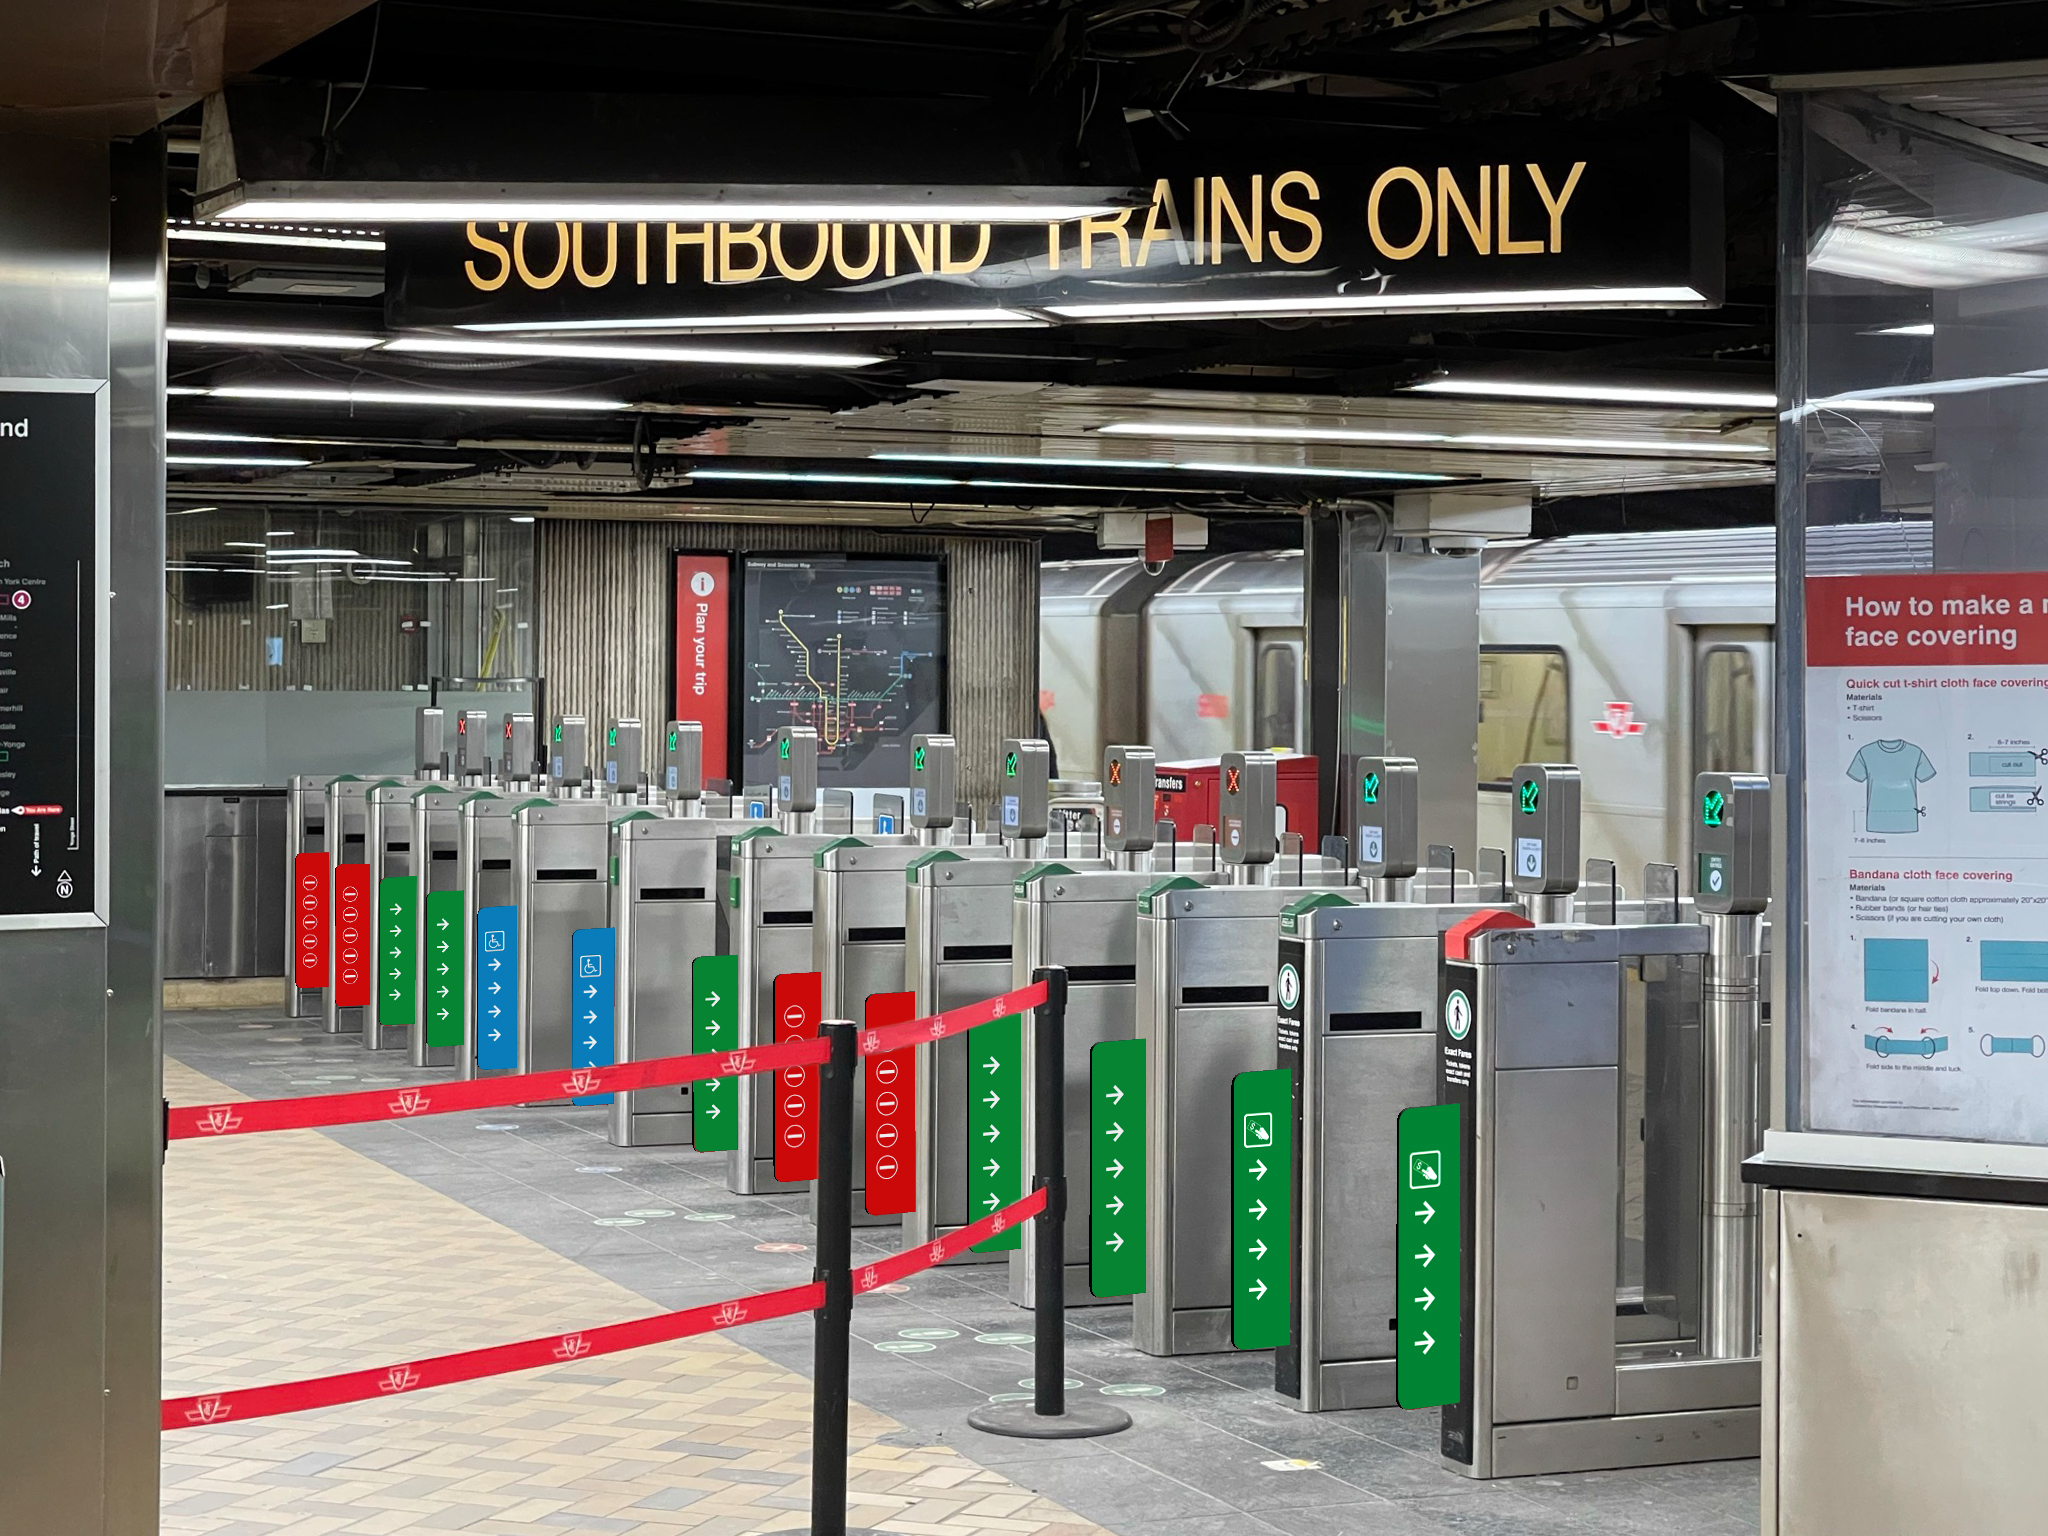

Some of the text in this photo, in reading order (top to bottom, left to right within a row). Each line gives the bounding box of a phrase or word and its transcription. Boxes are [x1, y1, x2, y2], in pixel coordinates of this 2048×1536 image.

[1367, 160, 1589, 262] ONLY
[17, 595, 25, 605] 4
[1845, 596, 1901, 617] How
[1908, 596, 1933, 616] to
[1942, 595, 2011, 616] make
[2018, 599, 2034, 615] a
[1845, 625, 2017, 650] face covering
[692, 603, 709, 696] Plan your trip
[1846, 677, 2048, 689] Quick cut t-shirt cloth face covering
[1846, 693, 1883, 701] Materials
[1853, 704, 1875, 712] T-shirt
[1853, 714, 1883, 722] Scissors
[2010, 738, 2031, 746] inches
[1154, 775, 1184, 791] ransfers
[33, 841, 40, 849] of
[1849, 869, 2014, 883] Bandana cloth face covering
[61, 885, 69, 895] N
[1849, 884, 1886, 892] Materials
[1855, 894, 1887, 903] Bandana
[1889, 894, 1899, 903] (or
[1900, 896, 1925, 904] square
[1926, 895, 1949, 903] cotton
[1950, 895, 1969, 904] cloth
[1969, 896, 2020, 906] approximately
[1855, 904, 1882, 912] Rubber
[1883, 904, 1905, 912] bands
[1907, 904, 1917, 913] (or
[1934, 905, 1949, 914] ties)
[1855, 914, 1886, 922] Scissors
[1887, 914, 1895, 924] (if
[1895, 916, 1909, 925] you
[1924, 915, 1948, 924] cutting
[1949, 917, 1967, 926] your
[1984, 916, 2005, 926] cloth)
[1991, 986, 2001, 994] top
[1881, 1006, 1908, 1014] bandana
[1277, 1015, 1301, 1028] Exact Fares
[1444, 1046, 1472, 1060] Exact Fares
